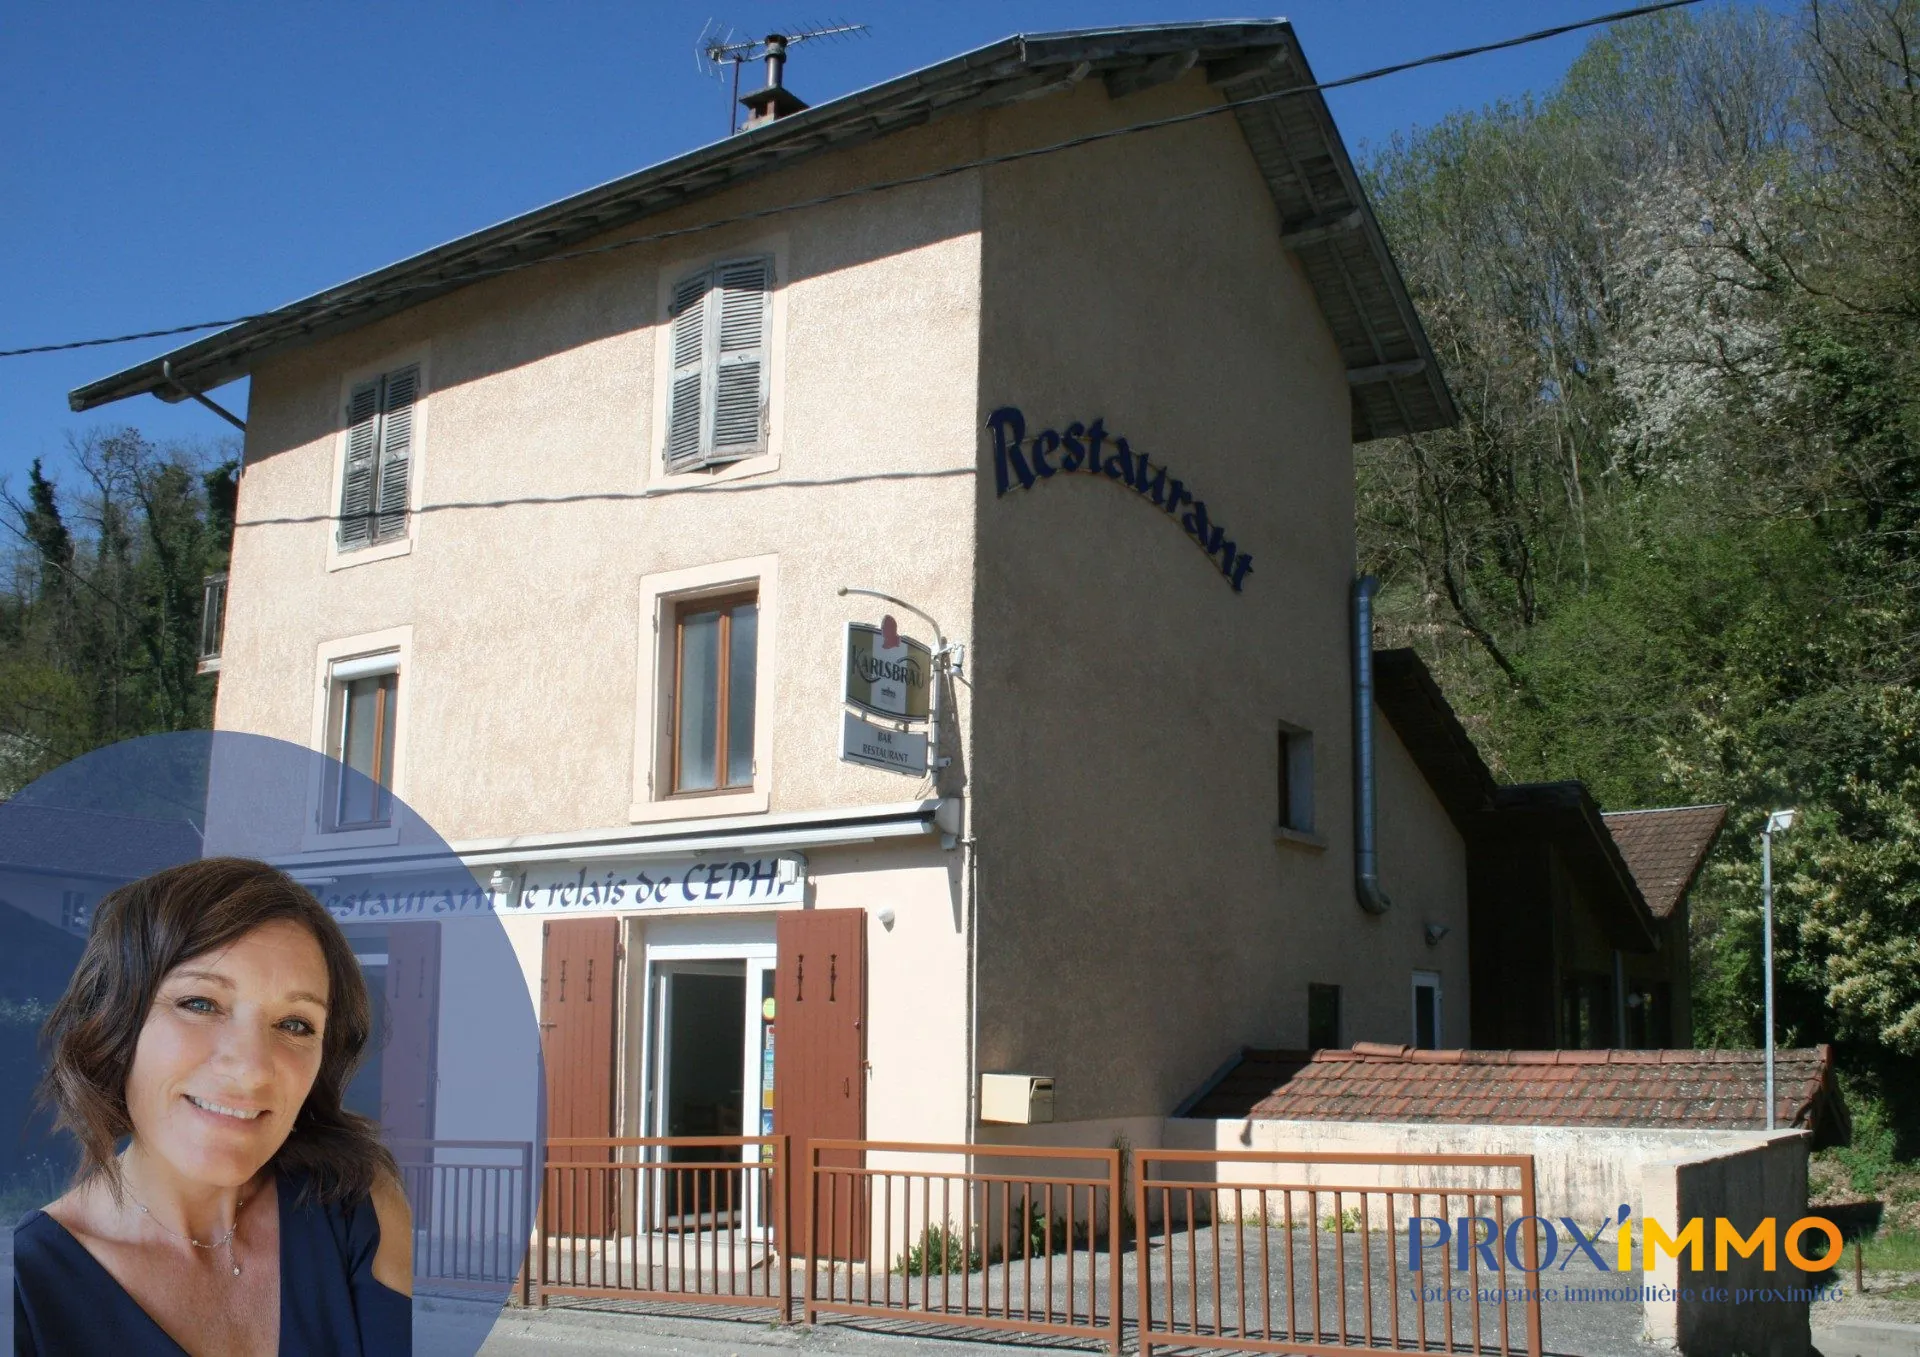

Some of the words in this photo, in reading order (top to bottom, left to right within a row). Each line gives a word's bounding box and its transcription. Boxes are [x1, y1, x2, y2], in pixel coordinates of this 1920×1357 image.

[985, 406, 1254, 592] Restaurant
[862, 744, 909, 762] RESTAURANT
[877, 731, 893, 744] BAR
[517, 870, 540, 908] le
[547, 866, 627, 907] relais
[635, 870, 672, 905] de
[682, 857, 786, 902] CEPH
